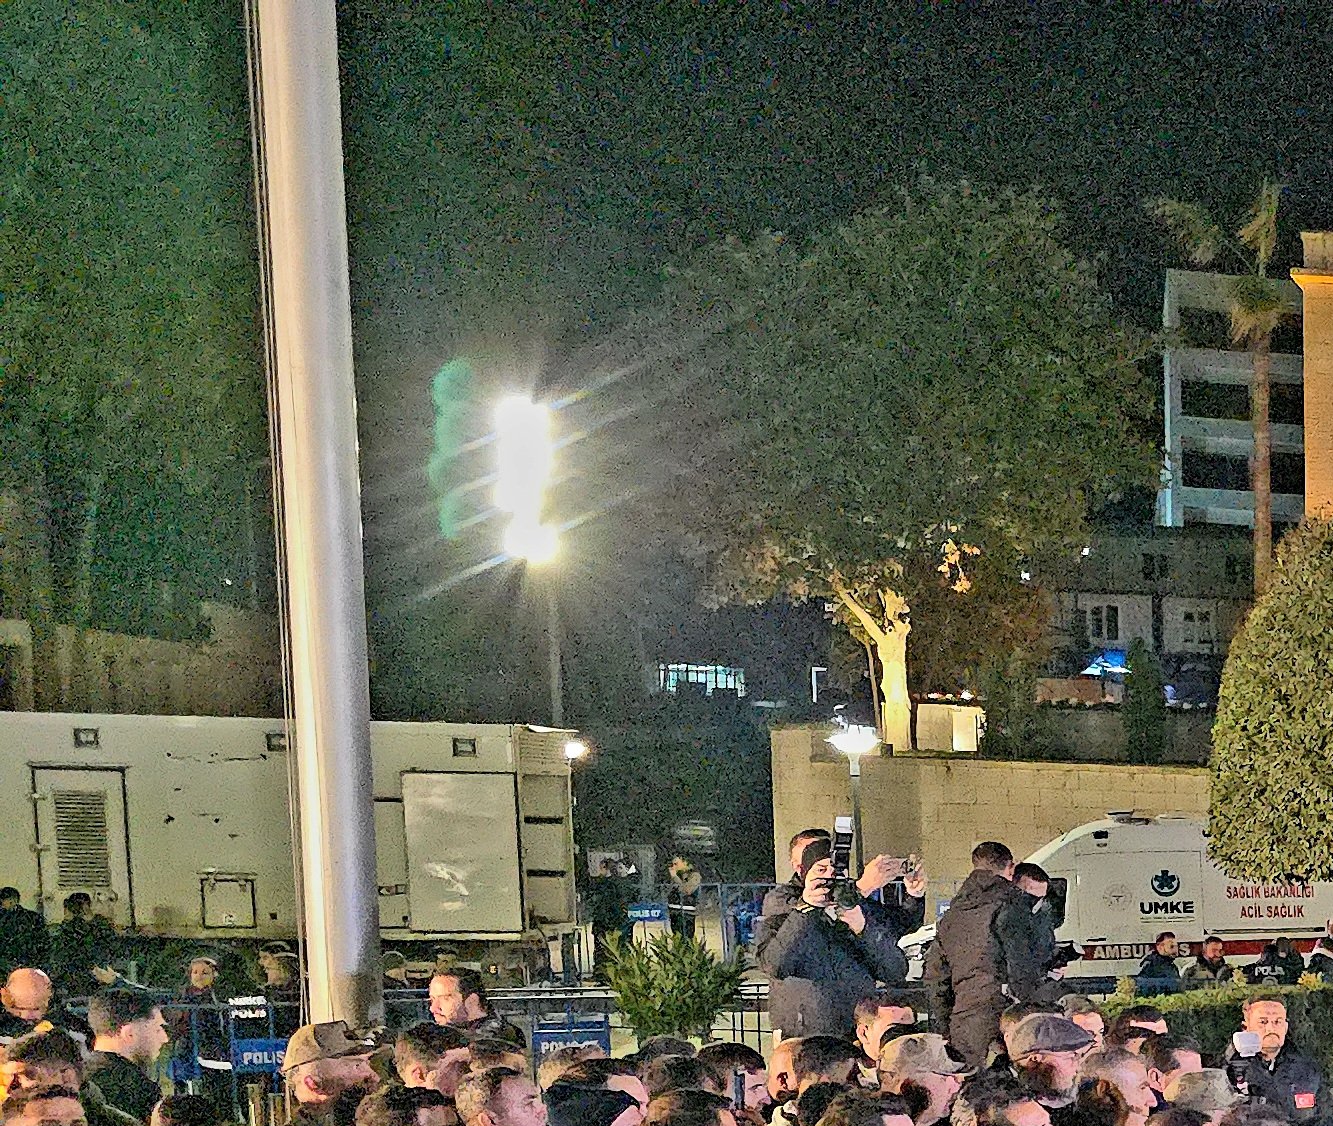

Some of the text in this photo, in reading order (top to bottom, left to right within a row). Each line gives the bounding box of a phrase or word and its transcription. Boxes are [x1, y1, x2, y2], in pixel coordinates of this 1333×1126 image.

[1226, 884, 1261, 899] SAĞLIK
[1140, 900, 1195, 915] UMKE
[1240, 903, 1305, 918] ACİL SAĞLIK
[1093, 942, 1191, 960] AMBULS
